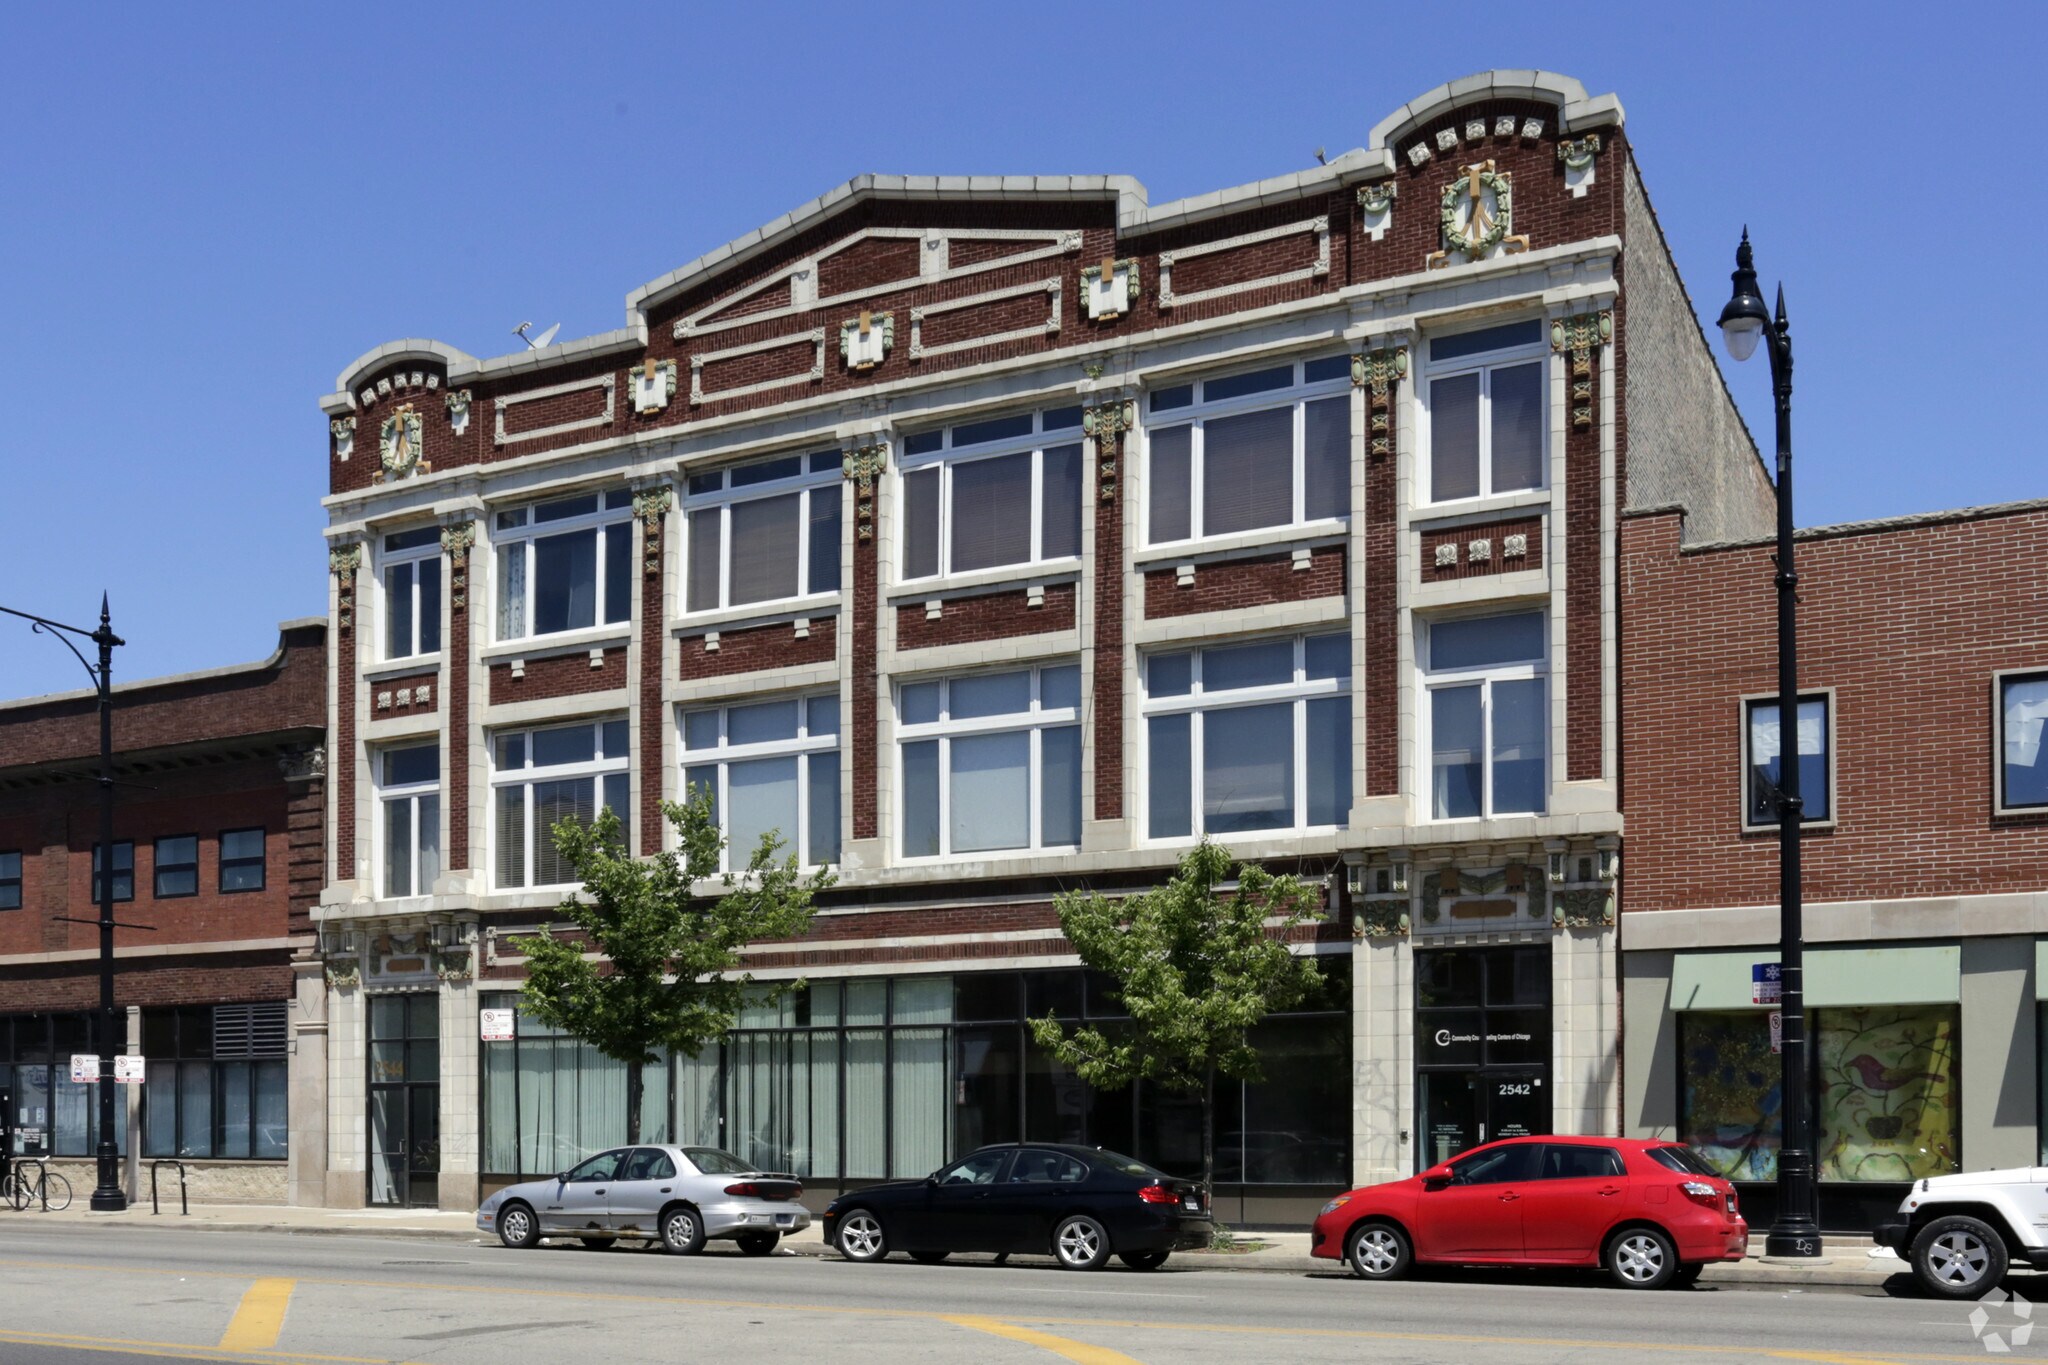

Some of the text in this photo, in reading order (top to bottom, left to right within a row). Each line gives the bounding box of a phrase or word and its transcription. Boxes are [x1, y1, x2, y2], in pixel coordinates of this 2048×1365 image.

[1452, 1034, 1472, 1042] Community
[1516, 1033, 1531, 1041] Chicago
[1499, 1084, 1531, 1095] 2542
